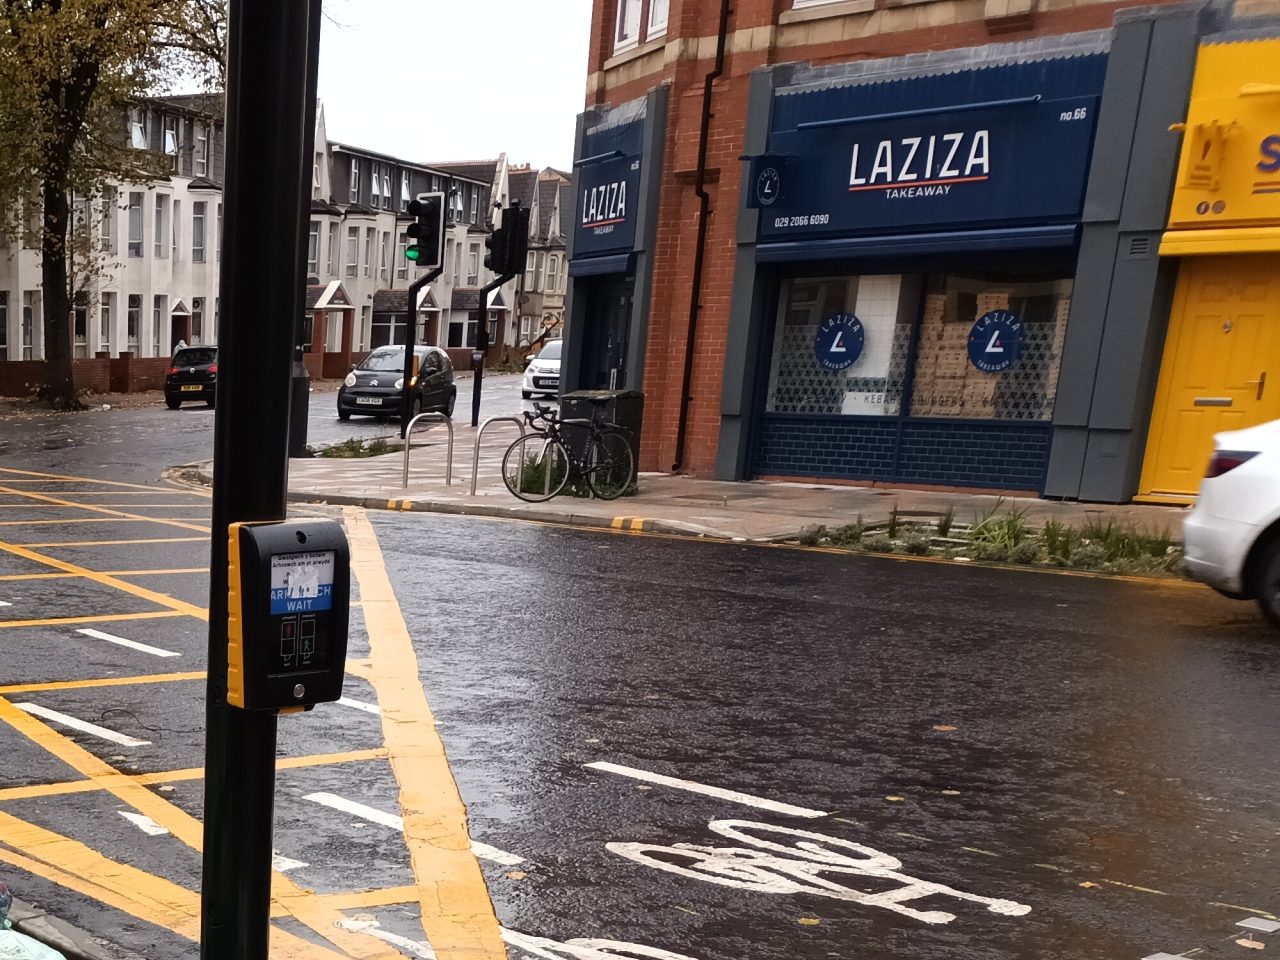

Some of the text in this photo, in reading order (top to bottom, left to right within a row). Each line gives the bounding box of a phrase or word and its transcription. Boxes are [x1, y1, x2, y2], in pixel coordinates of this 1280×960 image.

[1060, 108, 1087, 121] no.66
[849, 130, 990, 185] LAZIZA
[886, 184, 951, 200] TAKEAWAY
[582, 181, 626, 224] LAZIZA
[774, 214, 829, 228] 029 2066 6090
[822, 315, 861, 333] LAZIZA
[976, 312, 1021, 332] LAZIZA
[287, 600, 312, 611] WAIT
